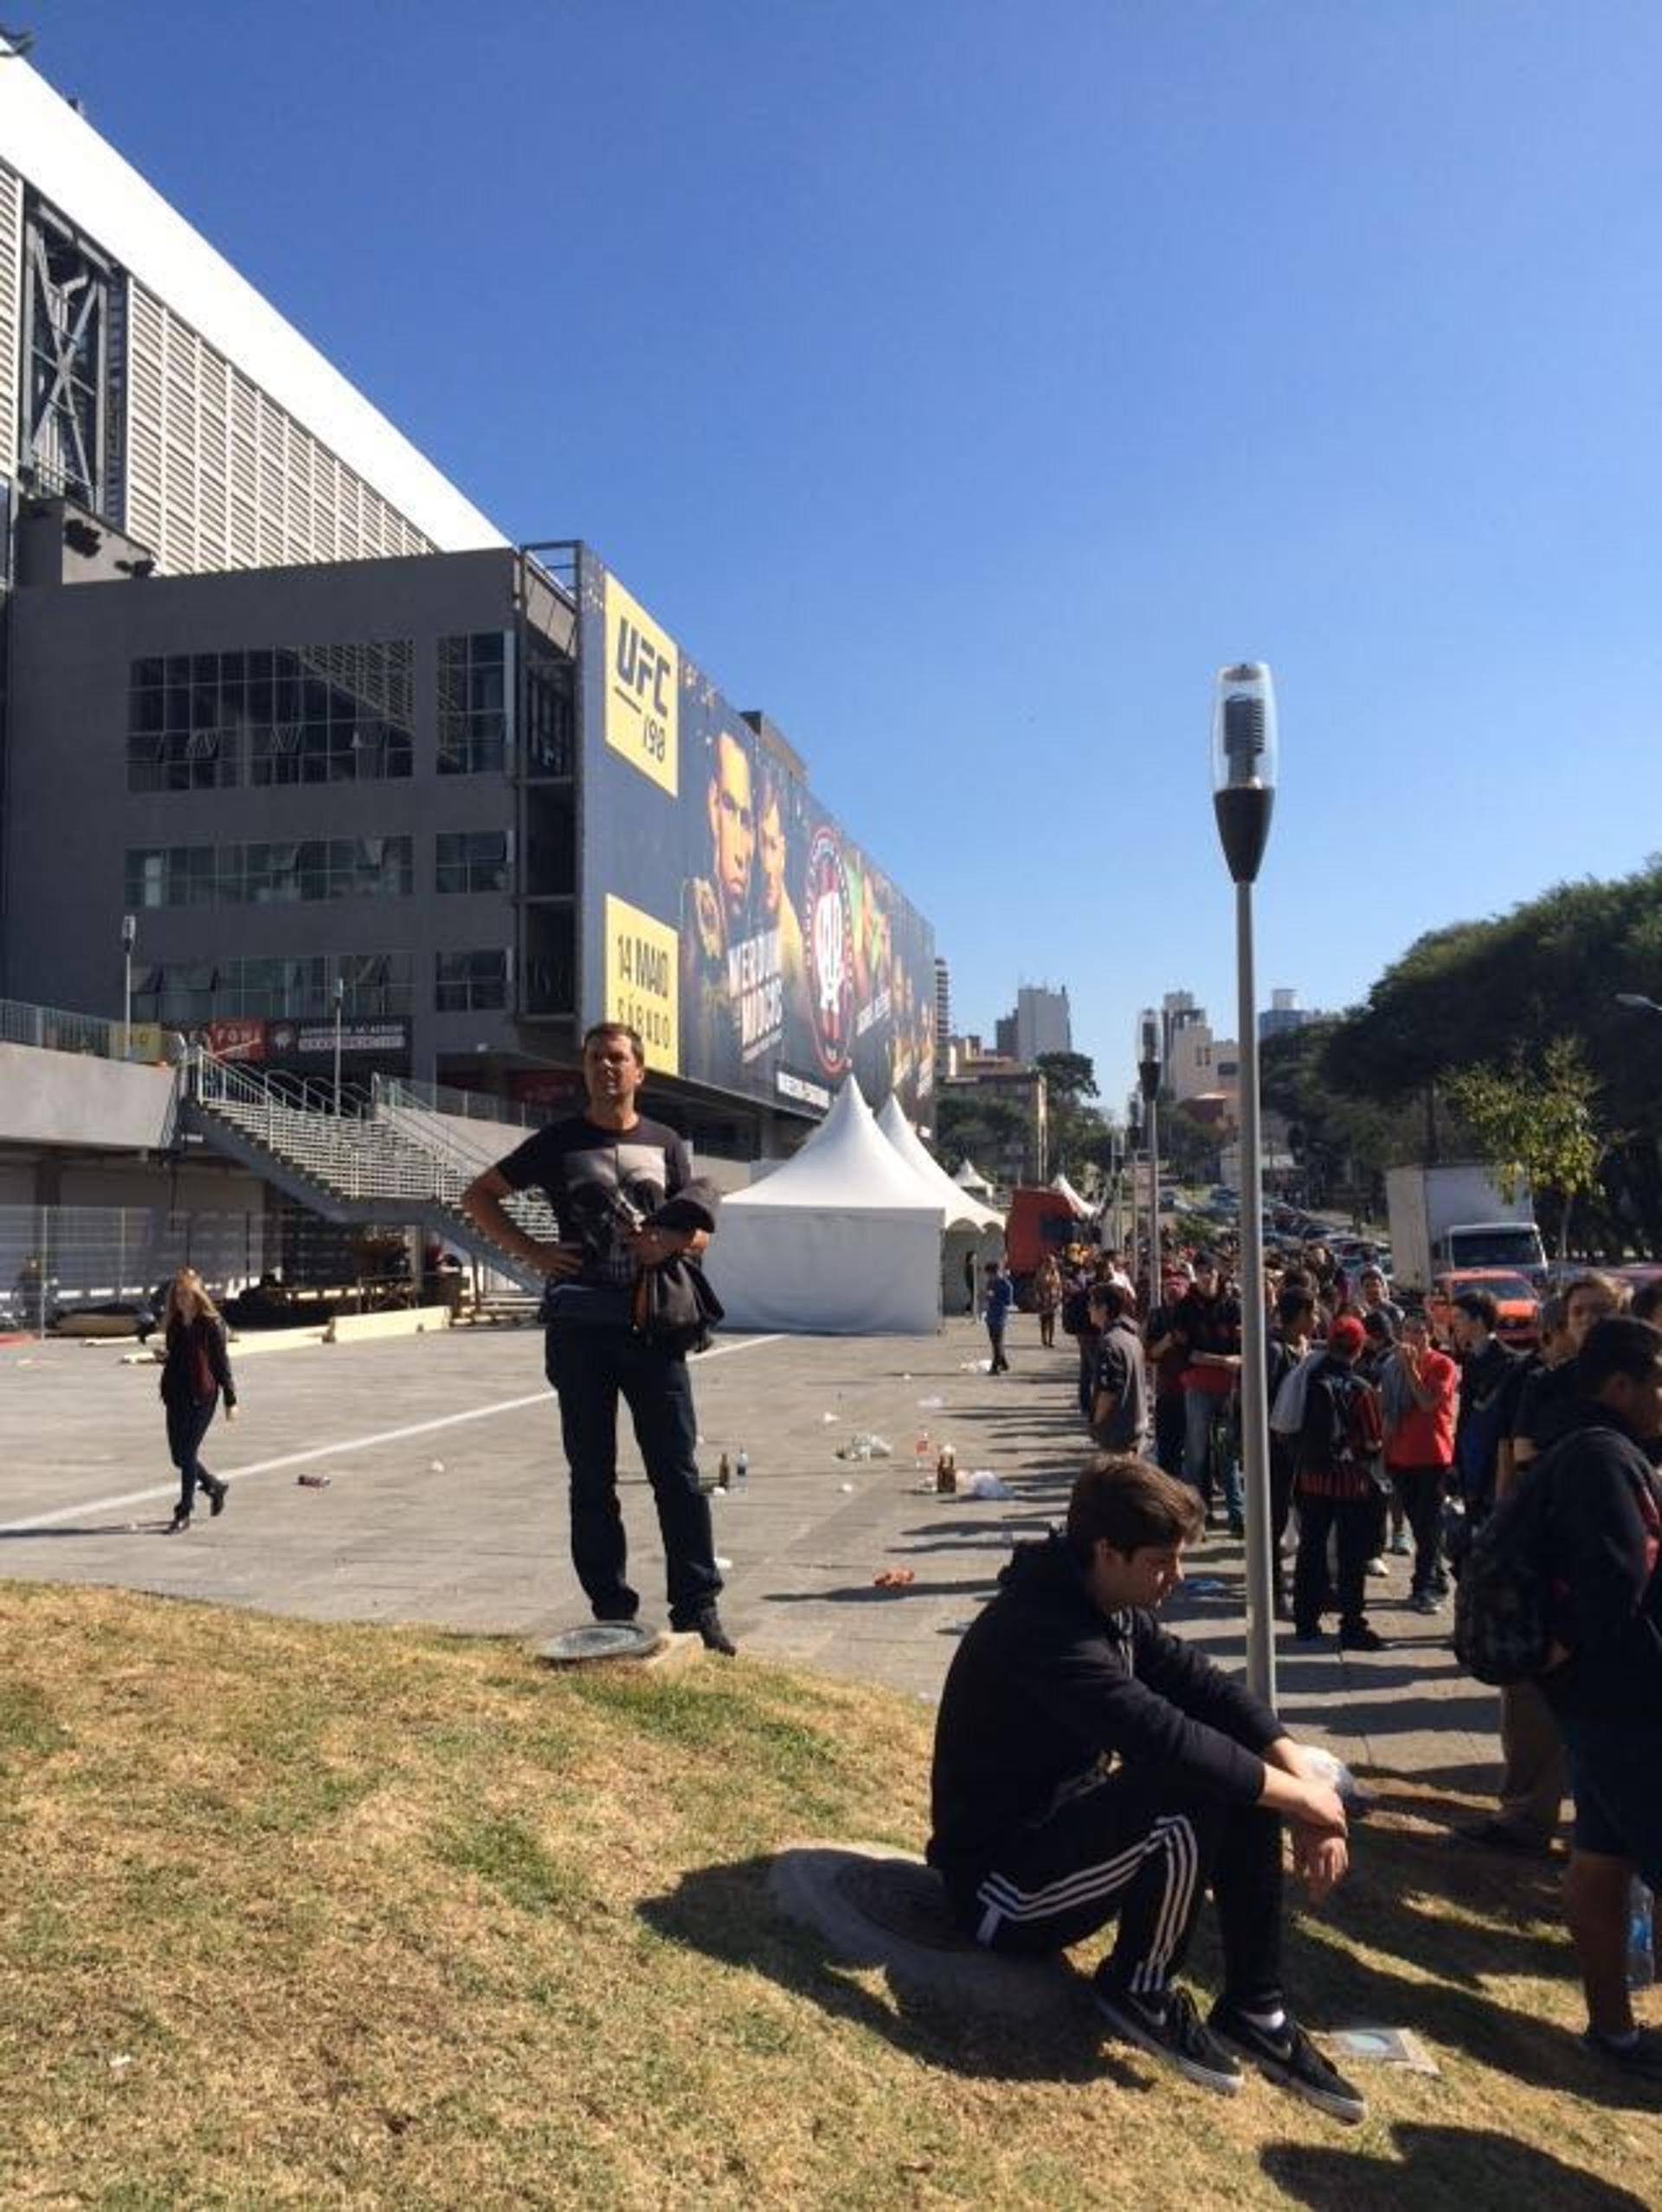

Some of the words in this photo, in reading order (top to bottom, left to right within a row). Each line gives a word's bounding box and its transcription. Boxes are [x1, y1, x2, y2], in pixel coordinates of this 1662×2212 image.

[616, 616, 671, 717] UFC
[642, 714, 666, 764] 198
[617, 934, 632, 981] 14
[635, 937, 668, 1000] MAIO
